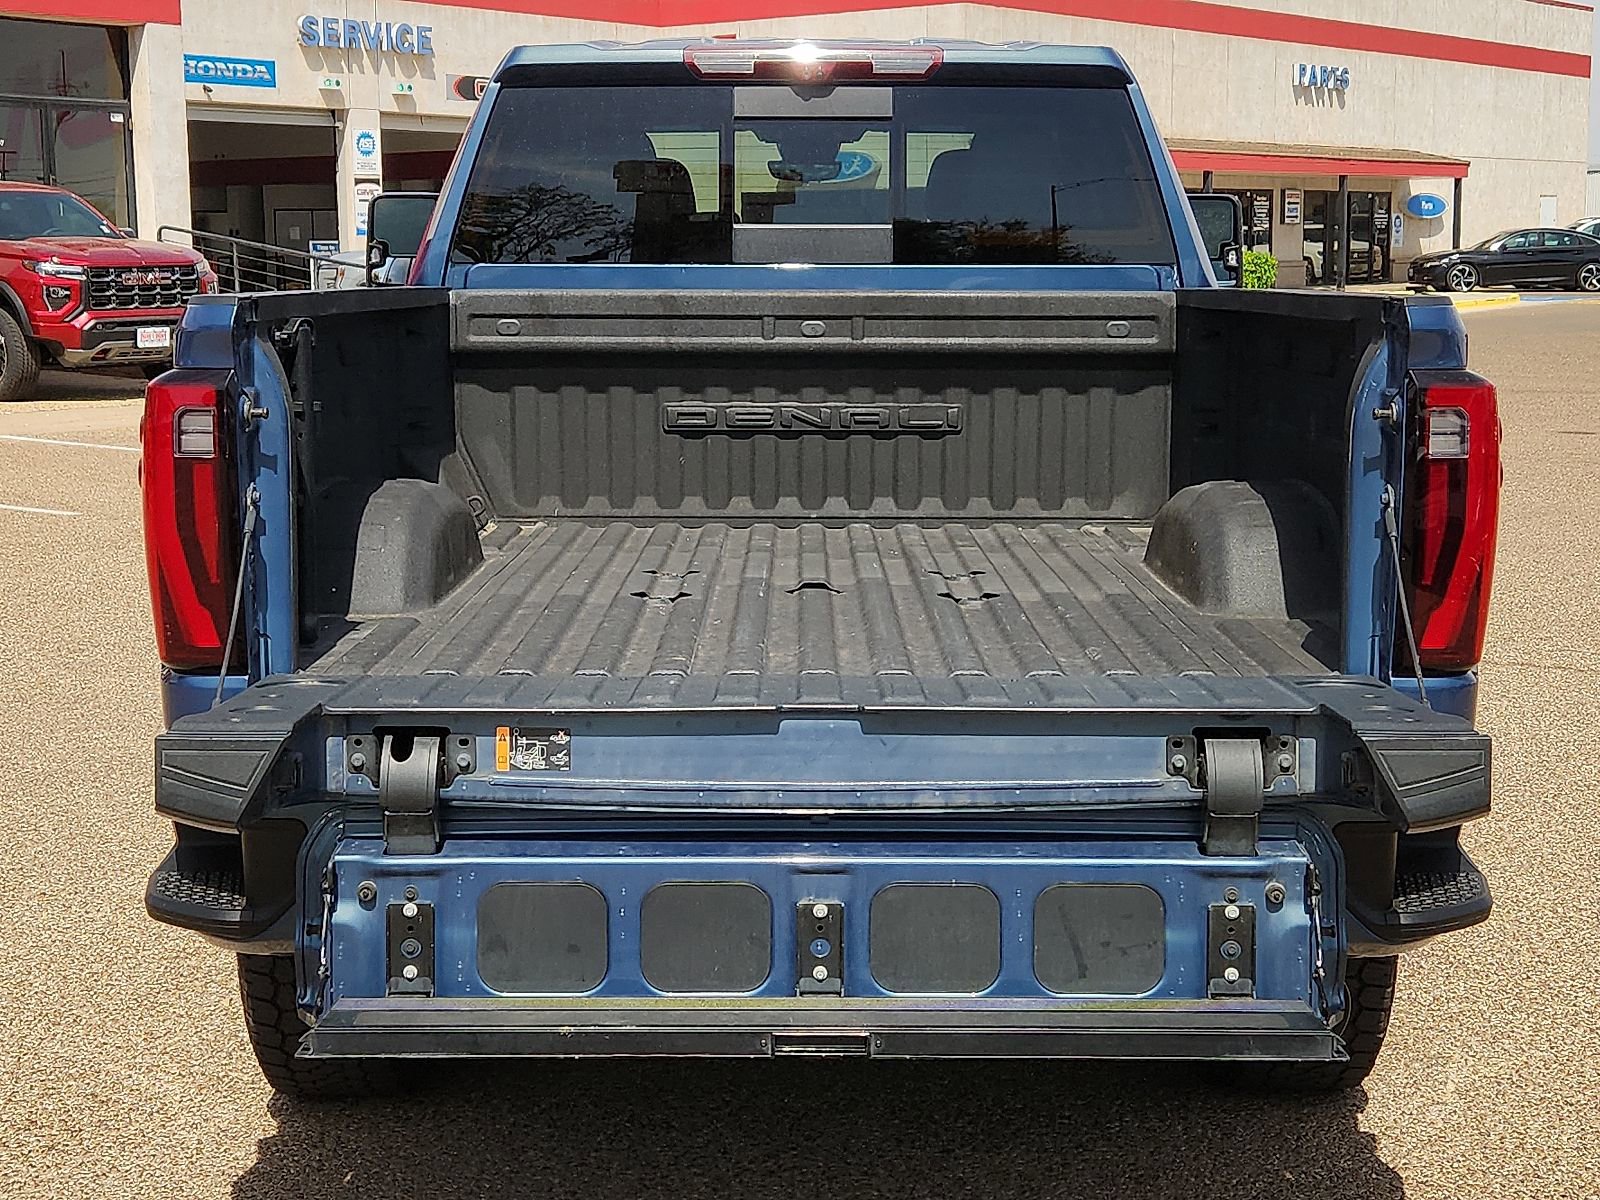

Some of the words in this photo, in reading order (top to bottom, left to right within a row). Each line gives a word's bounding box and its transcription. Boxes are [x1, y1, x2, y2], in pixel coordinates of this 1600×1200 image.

[299, 16, 433, 54] SERVICE
[184, 60, 272, 81] HONDA
[1296, 64, 1350, 90] PARTS
[122, 271, 172, 286] GMC
[666, 406, 961, 431] DENALI
